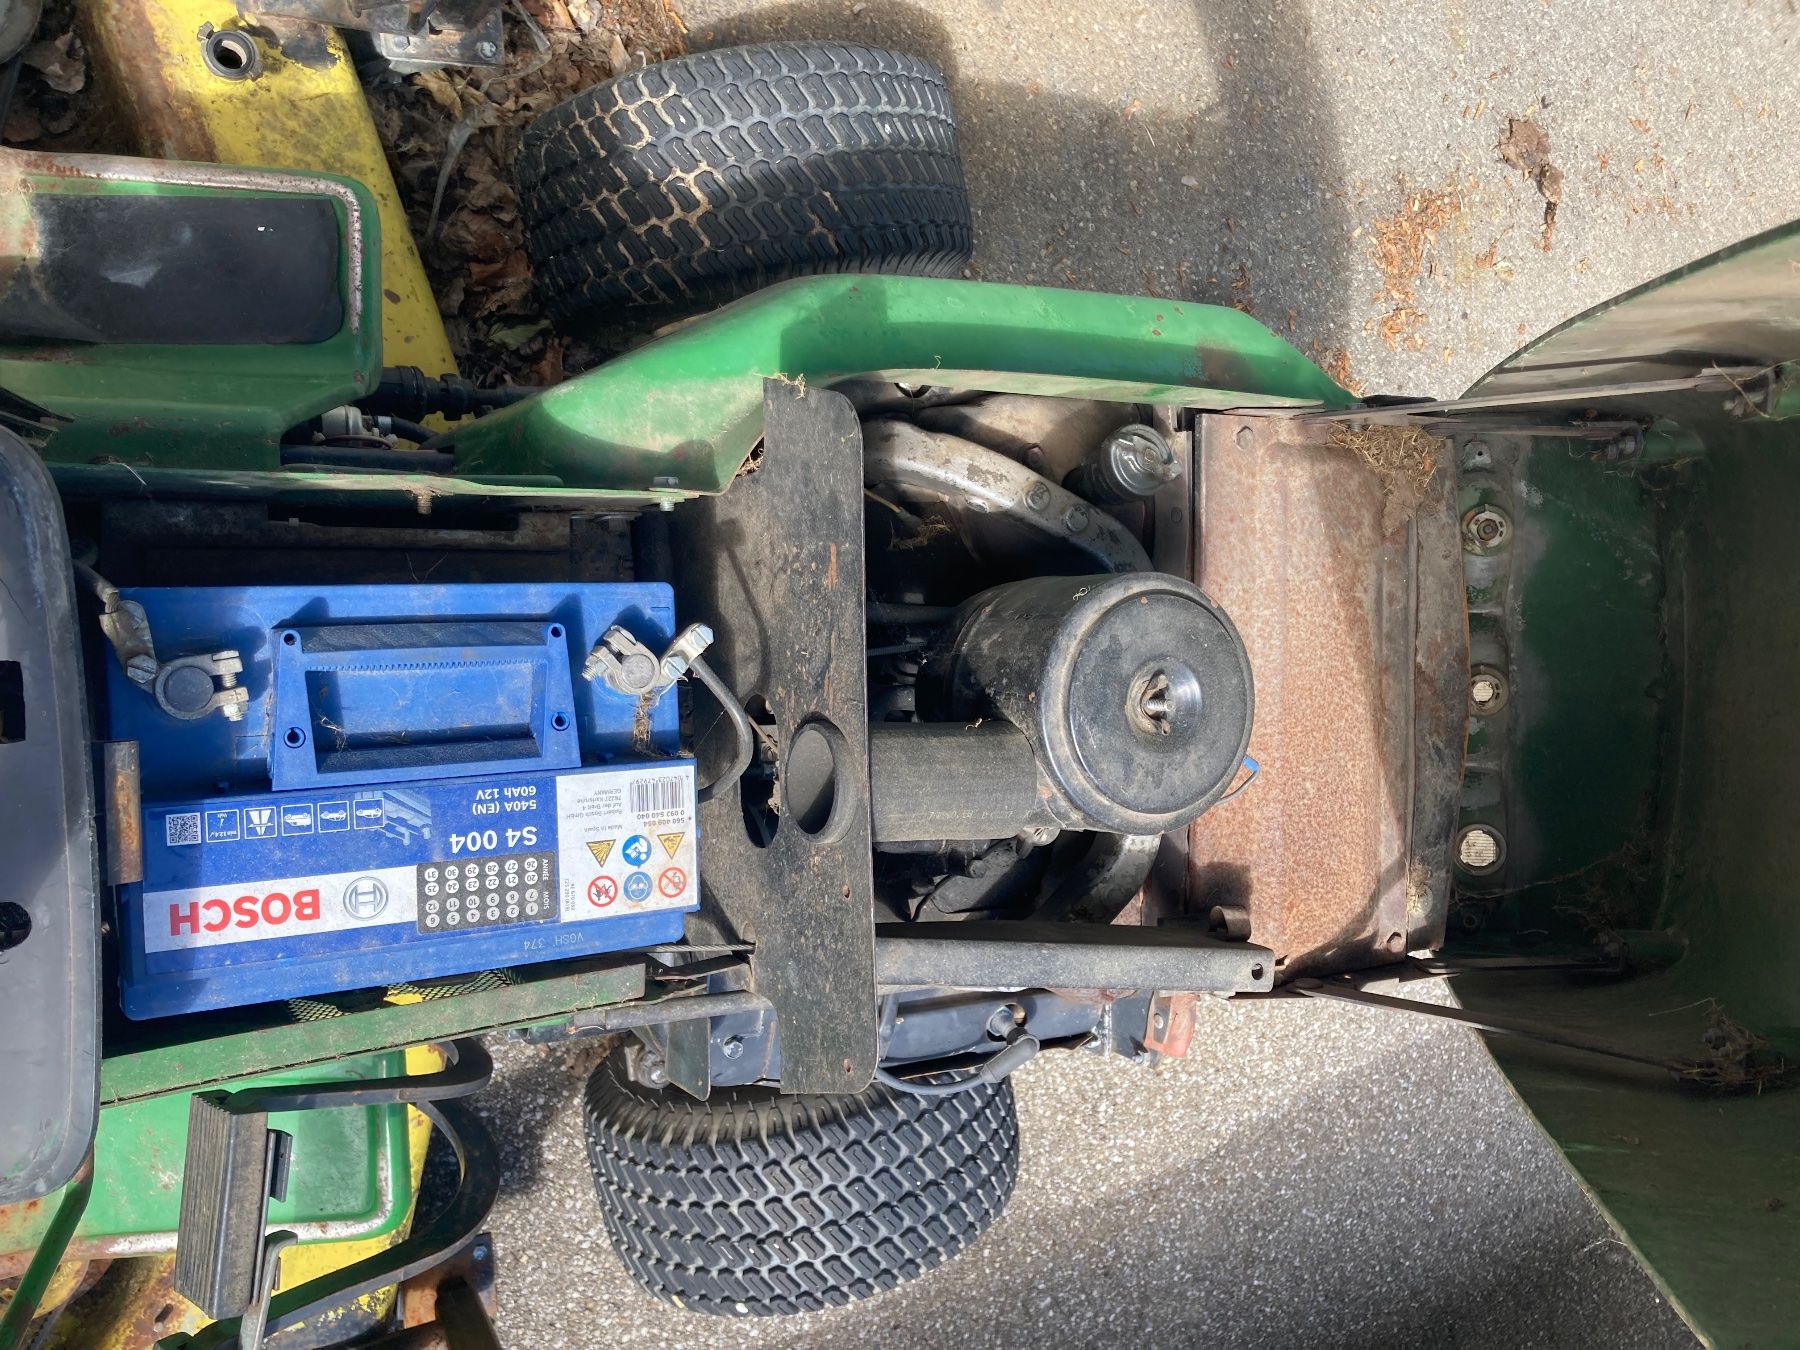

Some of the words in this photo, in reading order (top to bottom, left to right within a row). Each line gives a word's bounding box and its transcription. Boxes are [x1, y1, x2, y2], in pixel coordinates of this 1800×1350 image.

[475, 788, 500, 800] 12V
[504, 786, 537, 797] 60Ah
[472, 802, 500, 815] (EN)
[504, 800, 537, 812] 540A
[449, 829, 498, 854] 004
[505, 826, 538, 848] S4
[508, 876, 517, 884] 21
[526, 874, 536, 882] 20
[427, 885, 437, 893] 25
[467, 881, 477, 889] 23
[169, 889, 321, 936] BOSCH
[523, 938, 545, 950] 374
[555, 932, 584, 945] VGSH
